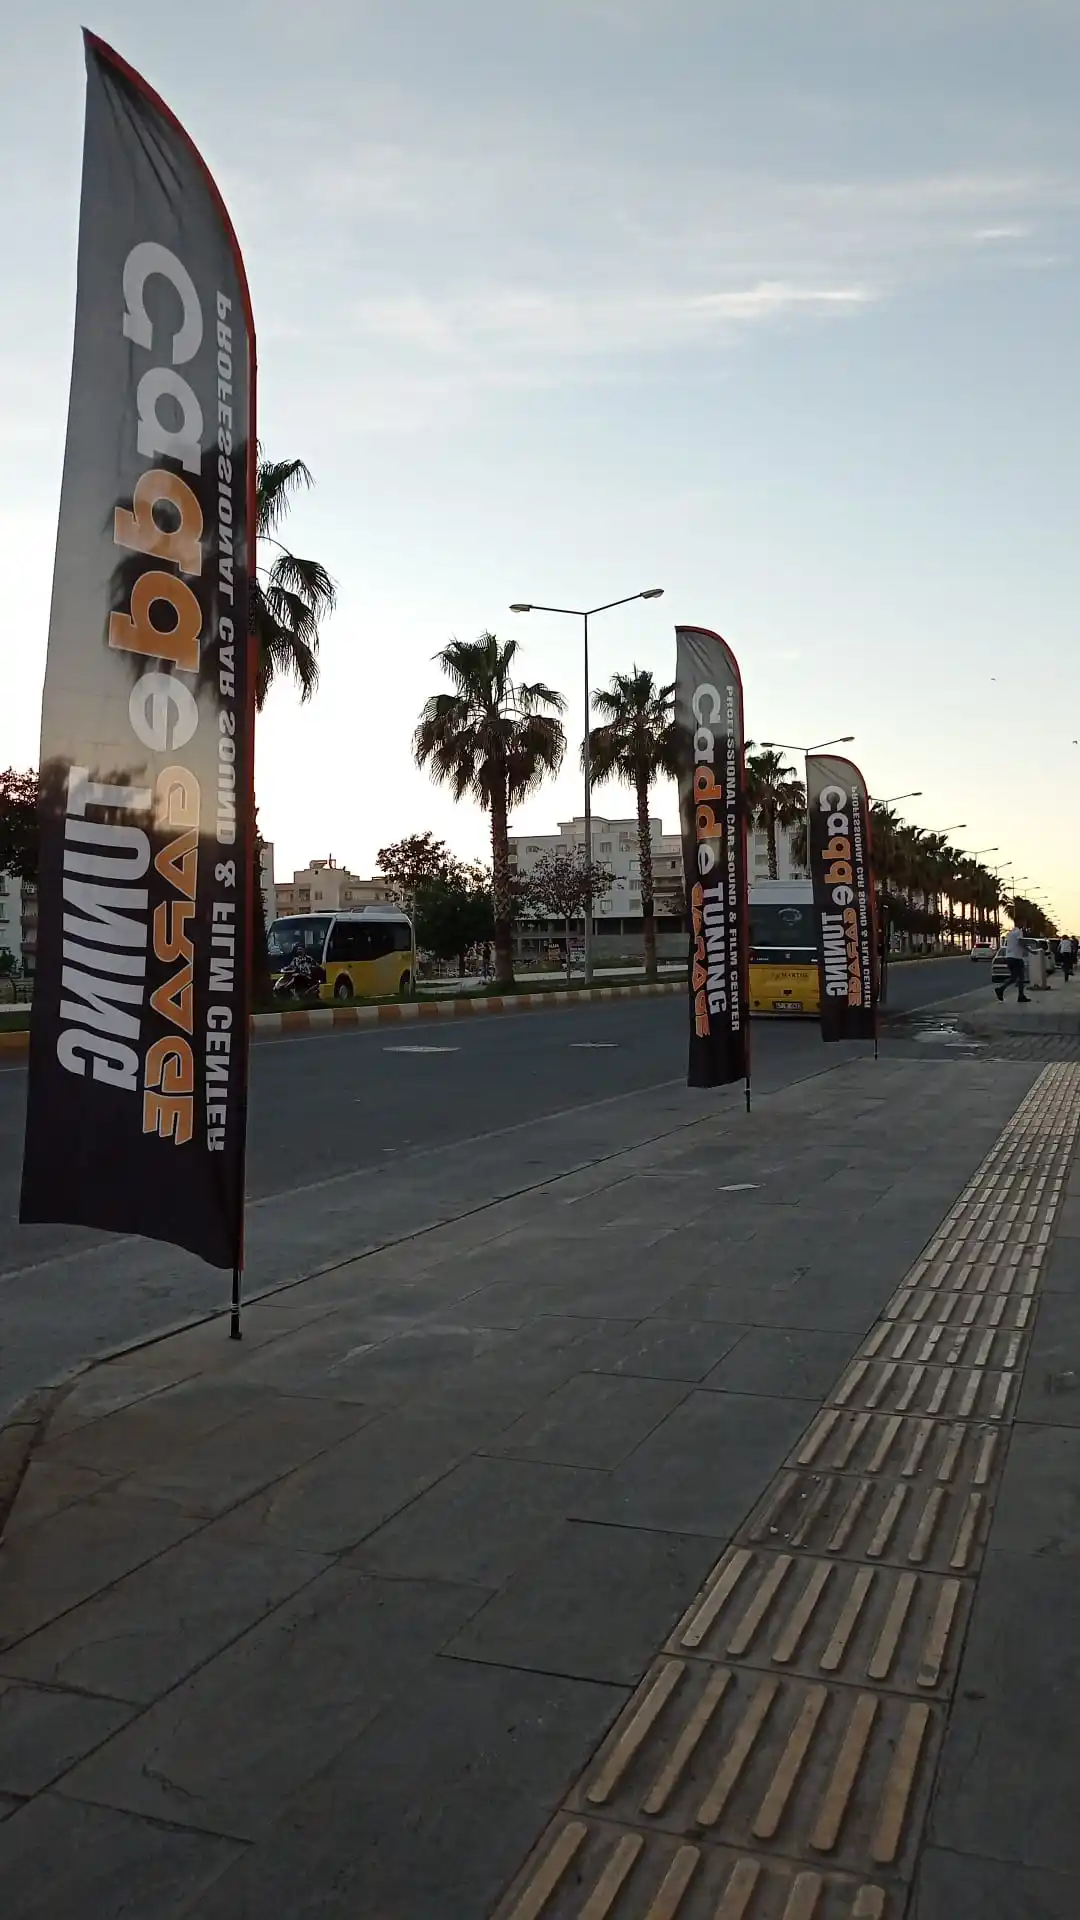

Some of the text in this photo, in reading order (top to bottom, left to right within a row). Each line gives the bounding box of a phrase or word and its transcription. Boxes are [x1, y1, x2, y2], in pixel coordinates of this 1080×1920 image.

[692, 682, 722, 876] Cadde
[726, 685, 740, 1031] PROFESSIONAL CAR SOUND & FILM CENTER
[703, 881, 727, 1015] TUNING
